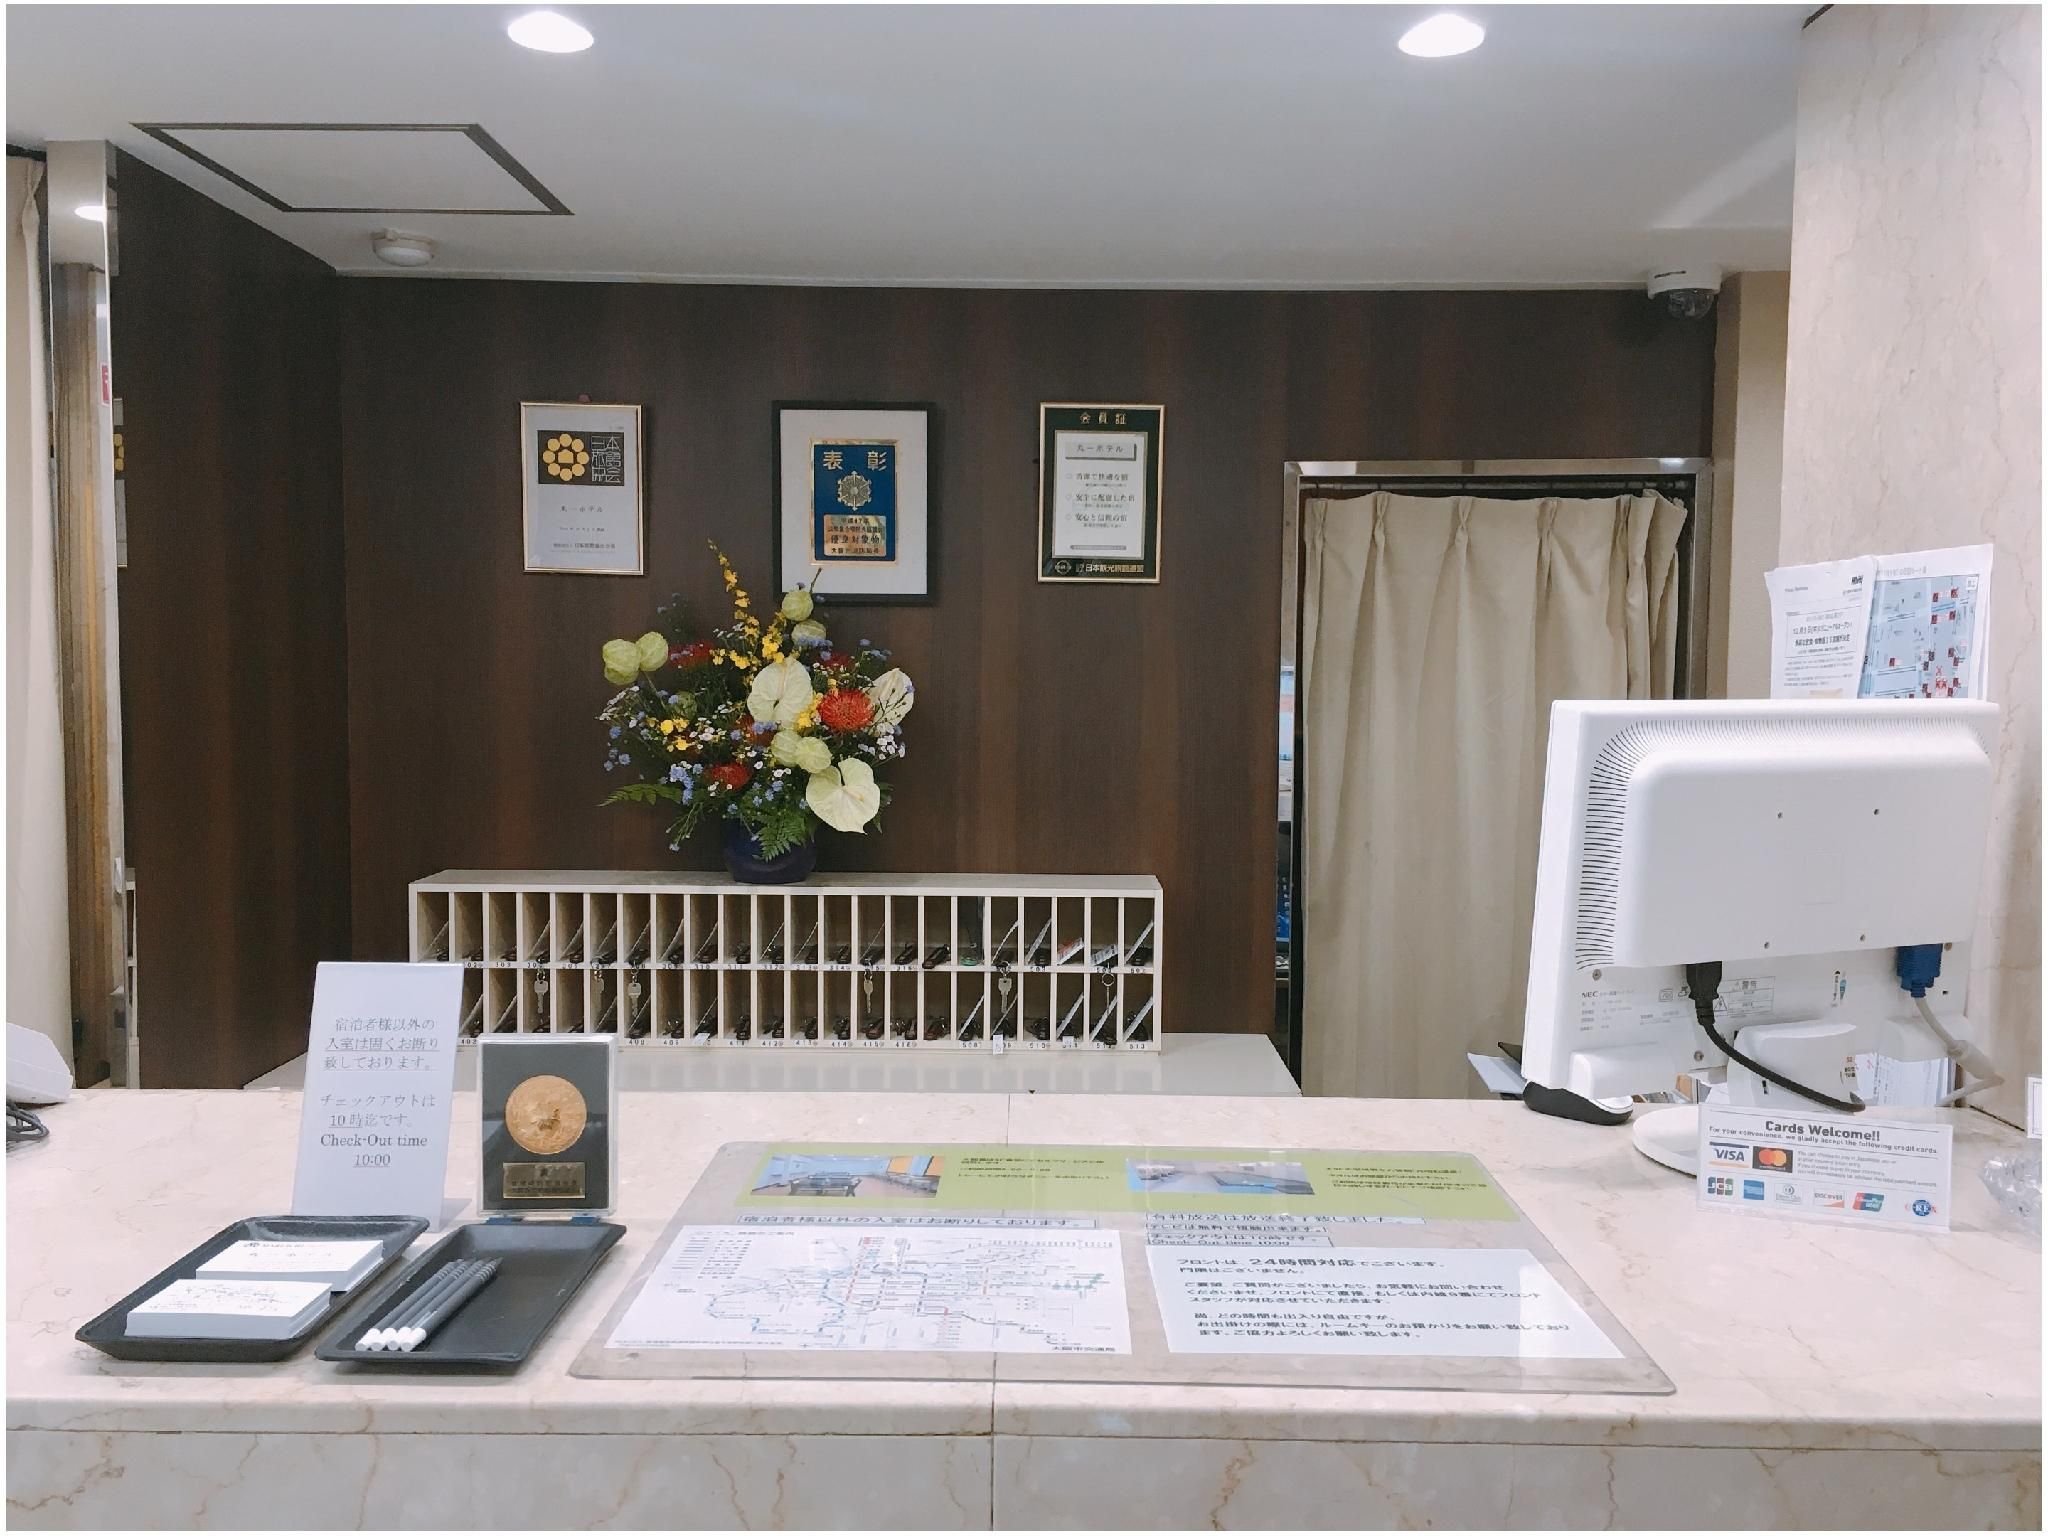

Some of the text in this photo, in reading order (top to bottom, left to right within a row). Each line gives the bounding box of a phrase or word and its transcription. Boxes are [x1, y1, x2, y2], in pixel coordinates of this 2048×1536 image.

[822, 449, 888, 472] 表彰
[1581, 990, 1599, 998] NEC
[335, 1017, 435, 1032] 宿泊者様以外の
[327, 1037, 439, 1051] 入室は固くお断り
[323, 1056, 432, 1071] 致しております。
[320, 1093, 436, 1108] チェックアウトは
[1709, 1125, 1720, 1133] For
[1845, 1139, 1857, 1147] the
[1858, 1141, 1892, 1151] following
[1765, 1120, 1880, 1141] Cards Welcome!!
[320, 1134, 428, 1148] Check-Out time
[353, 1154, 391, 1167] 10:00
[1713, 1148, 1745, 1162] VISA
